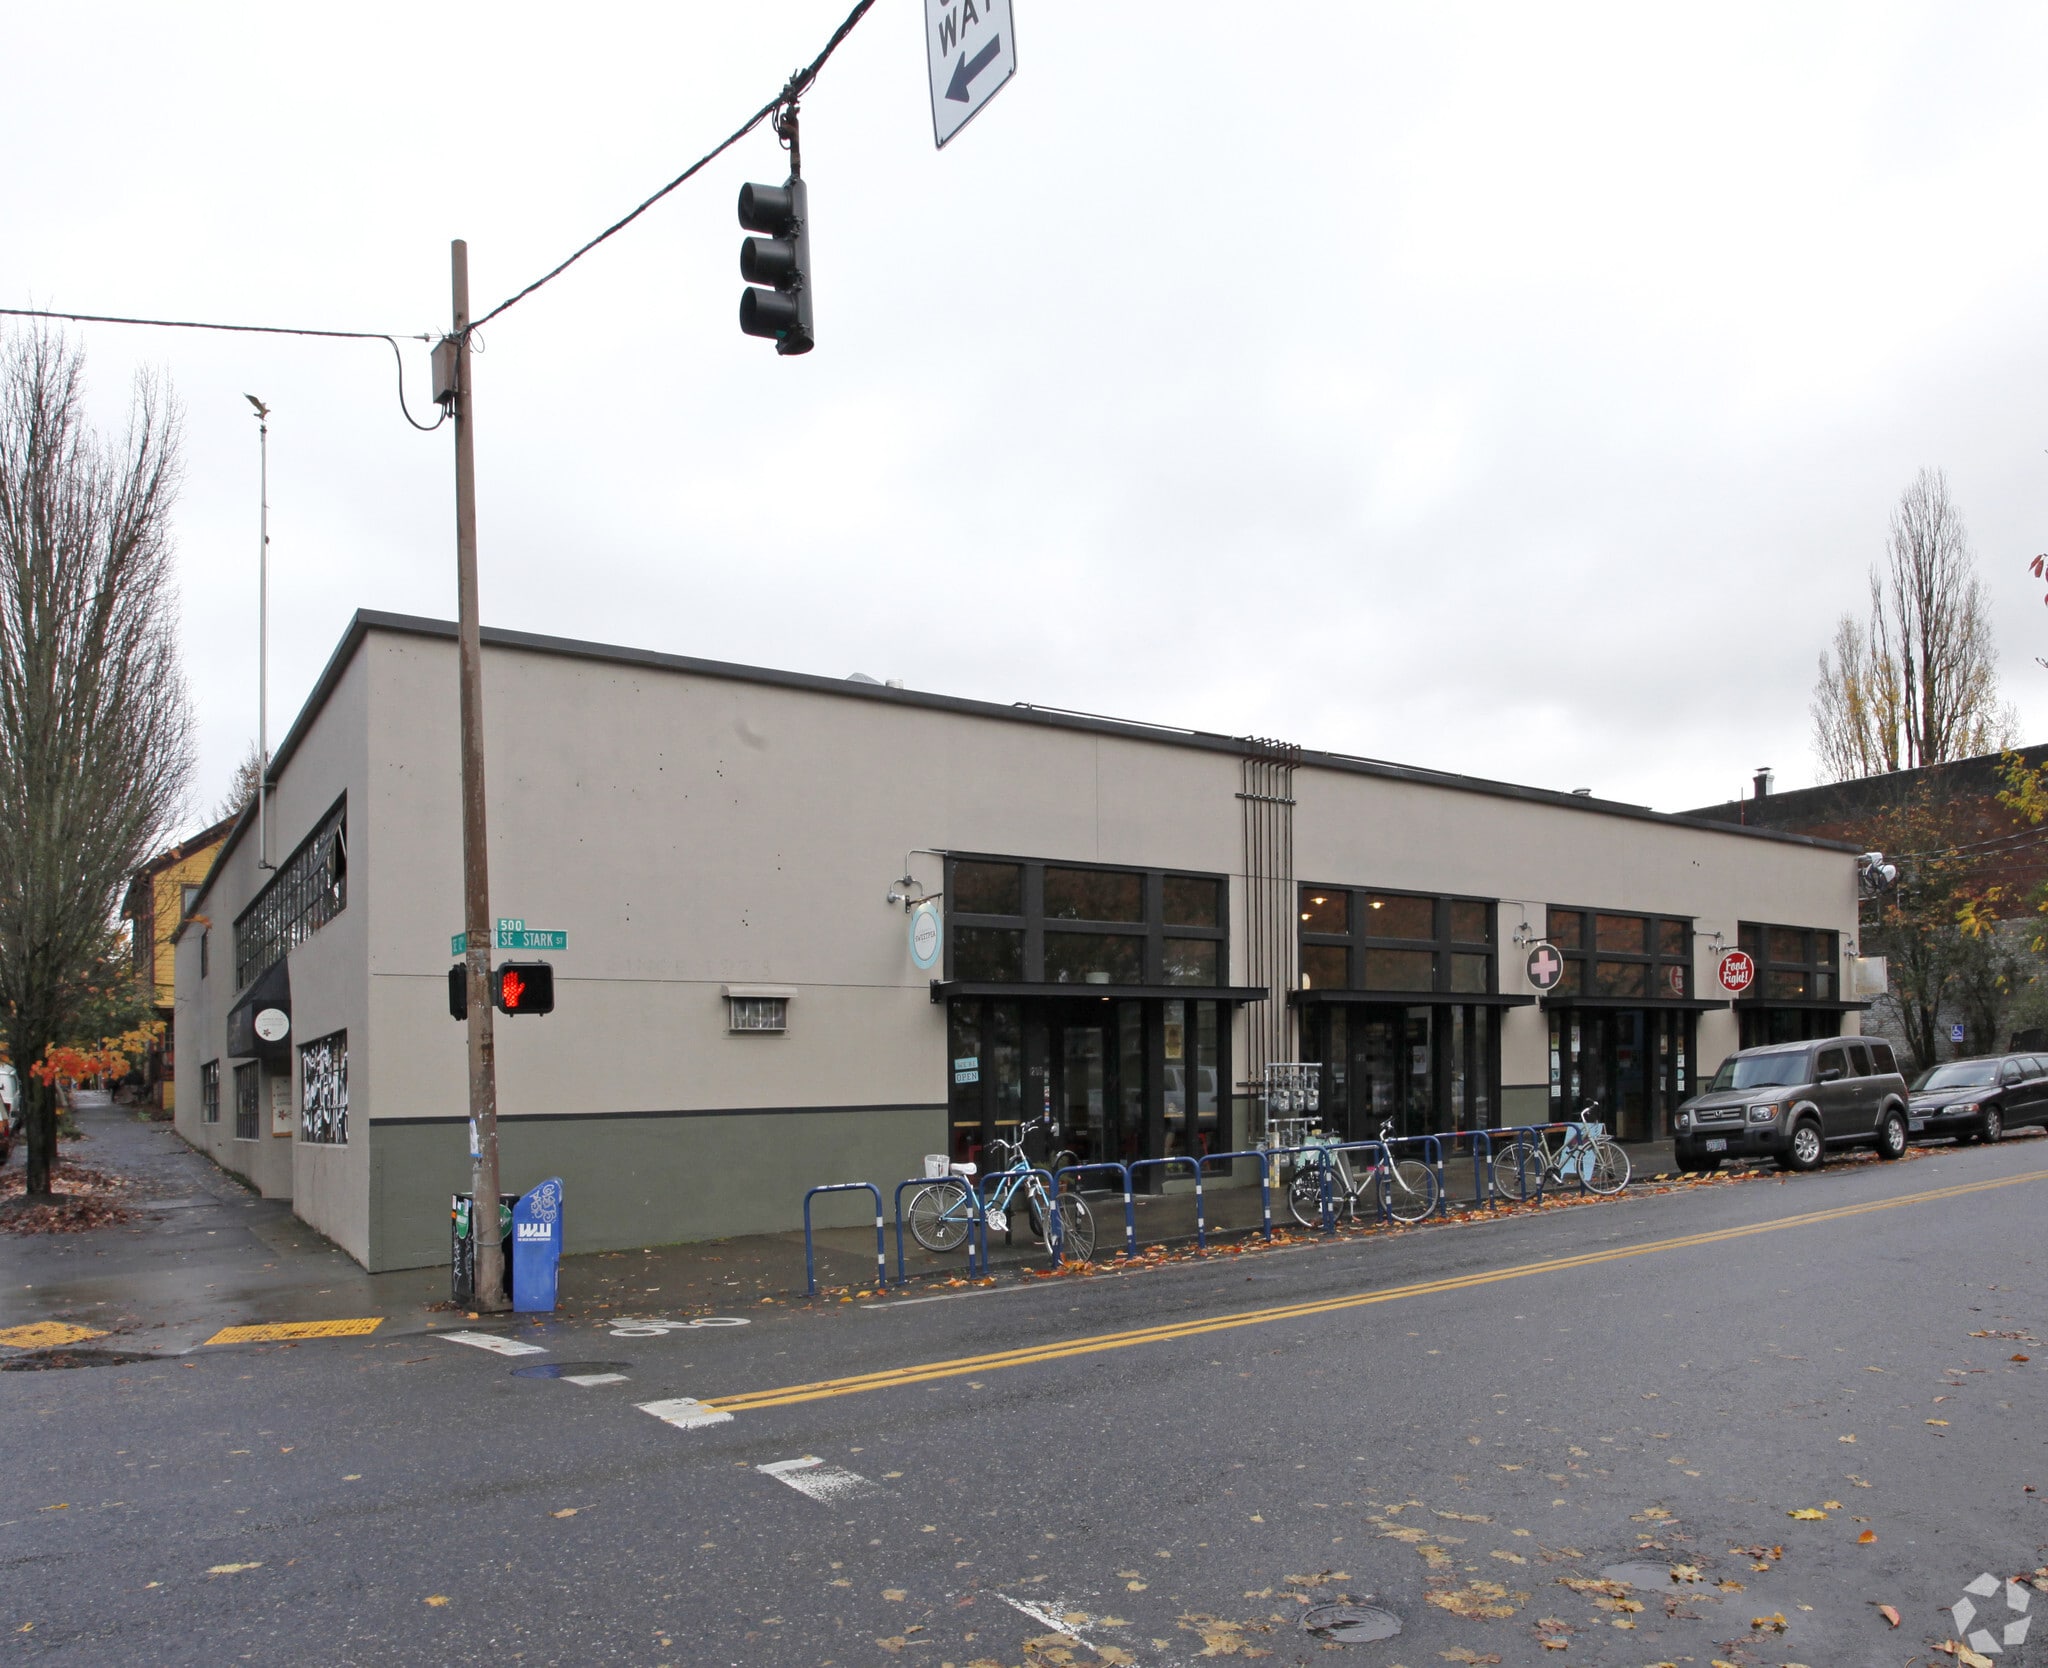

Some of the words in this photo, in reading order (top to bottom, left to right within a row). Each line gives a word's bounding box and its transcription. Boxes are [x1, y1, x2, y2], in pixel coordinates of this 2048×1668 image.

[938, 0, 991, 58] WA
[501, 920, 522, 931] 500
[501, 932, 514, 946] SE
[523, 932, 554, 947] STARK
[556, 937, 563, 945] ST
[1725, 957, 1747, 972] Food
[1723, 970, 1748, 987] Fight!
[956, 1072, 977, 1082] OPEN
